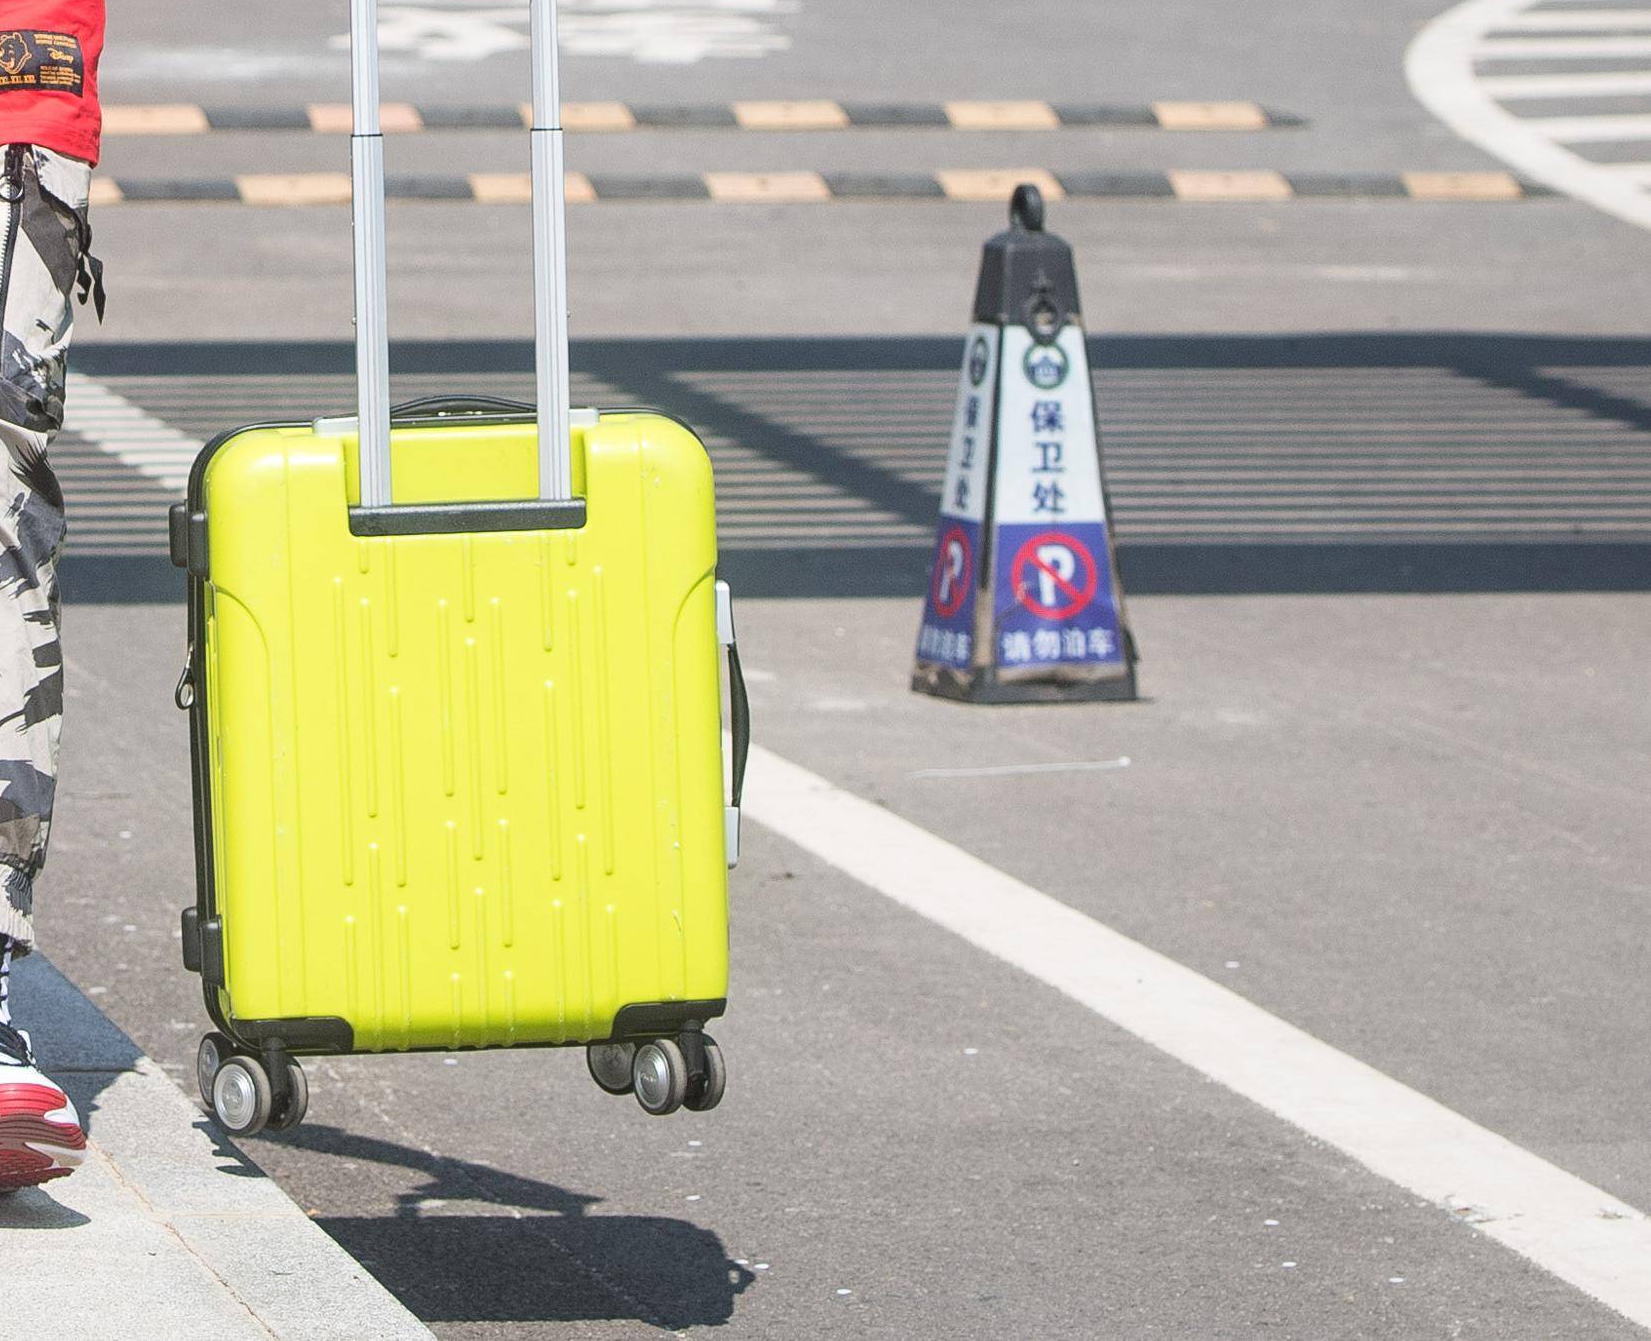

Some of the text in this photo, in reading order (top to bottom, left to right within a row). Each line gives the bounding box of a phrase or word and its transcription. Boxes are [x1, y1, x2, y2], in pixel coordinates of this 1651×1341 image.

[1029, 399, 1067, 514] 保卫处
[1002, 626, 1116, 662] 请勿泊车
